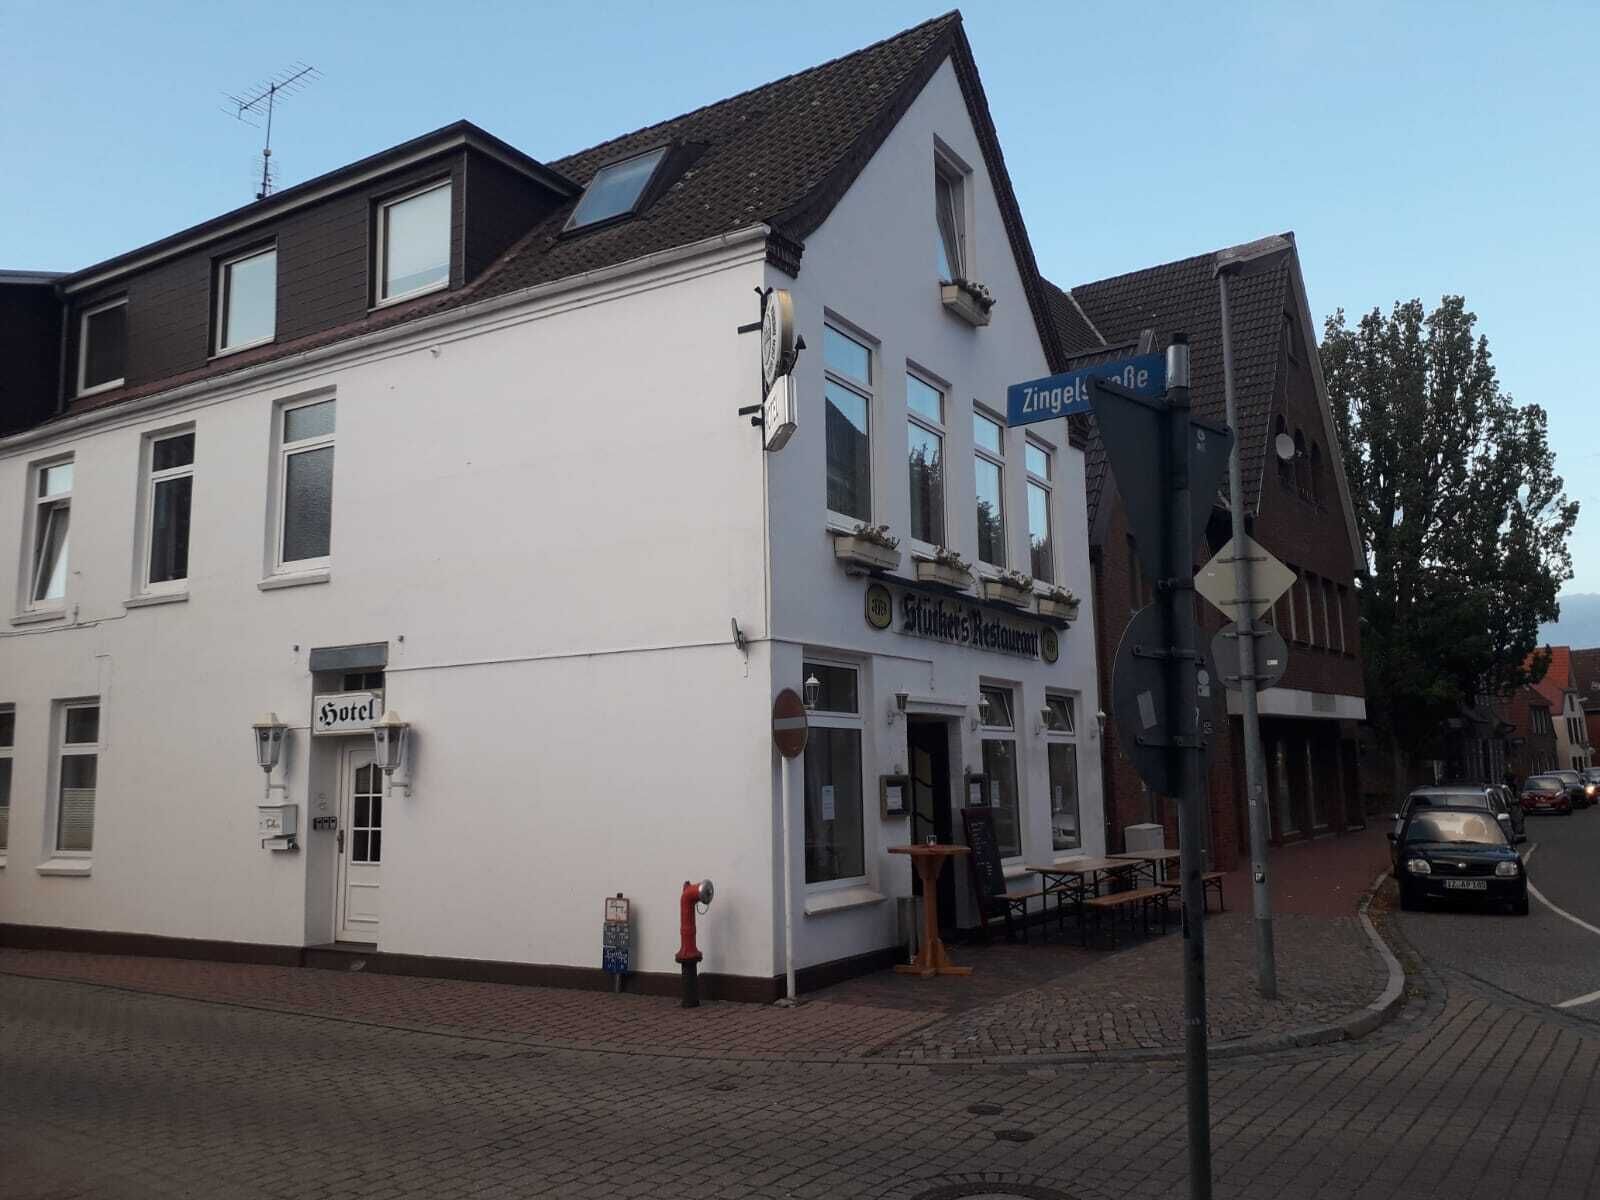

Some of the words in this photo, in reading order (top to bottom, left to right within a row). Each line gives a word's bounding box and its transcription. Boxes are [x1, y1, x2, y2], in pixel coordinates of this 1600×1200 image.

[1022, 365, 1148, 413] Zingelsße
[971, 607, 1039, 656] Restaurant
[319, 698, 375, 726] Hotel
